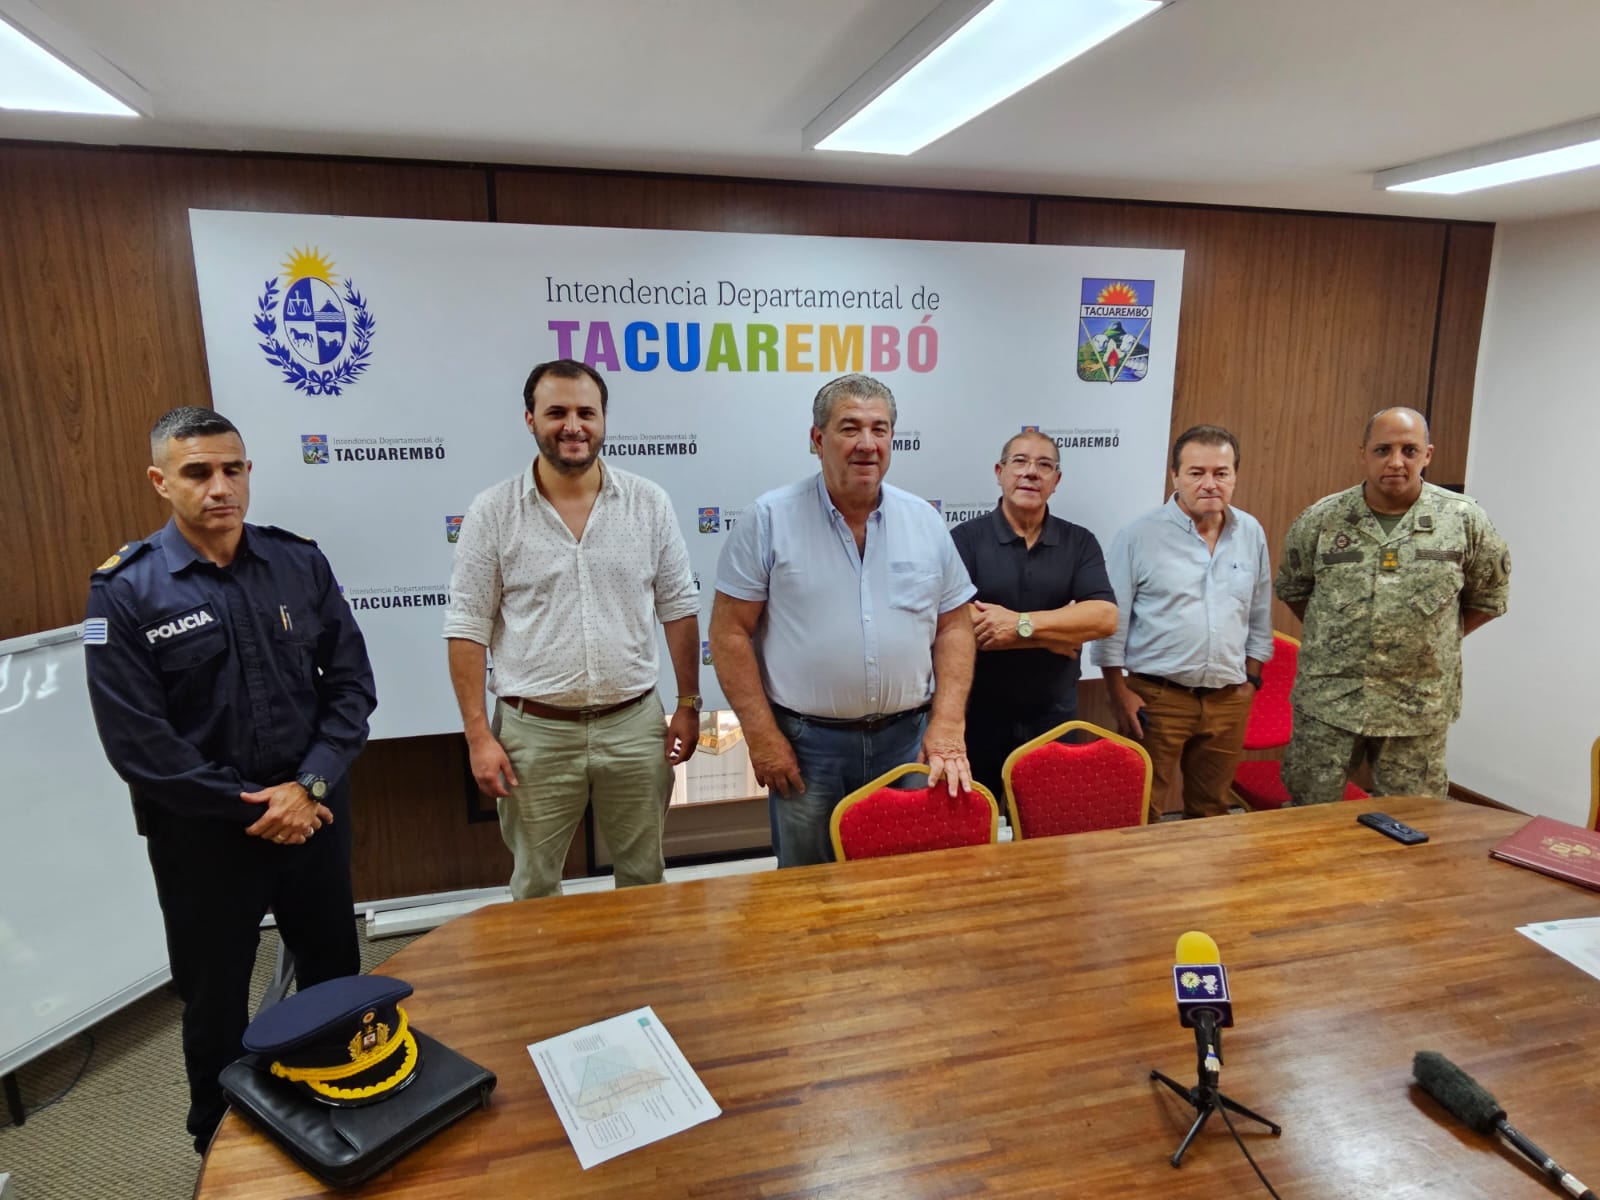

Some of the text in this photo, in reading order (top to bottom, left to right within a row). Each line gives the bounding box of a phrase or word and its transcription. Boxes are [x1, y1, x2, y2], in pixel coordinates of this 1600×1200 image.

[545, 276, 940, 314] Intendencia Departamental de
[1084, 305, 1149, 317] TACUAREMBÓ
[547, 314, 939, 373] TACUAREMBÓ
[602, 440, 698, 456] TACUAREMBÓ
[1055, 434, 1120, 448] CUAREMBÓ
[335, 444, 446, 461] TACUAREMBÓ
[351, 594, 451, 610] TACUAREMB
[145, 610, 214, 644] POLICIA
